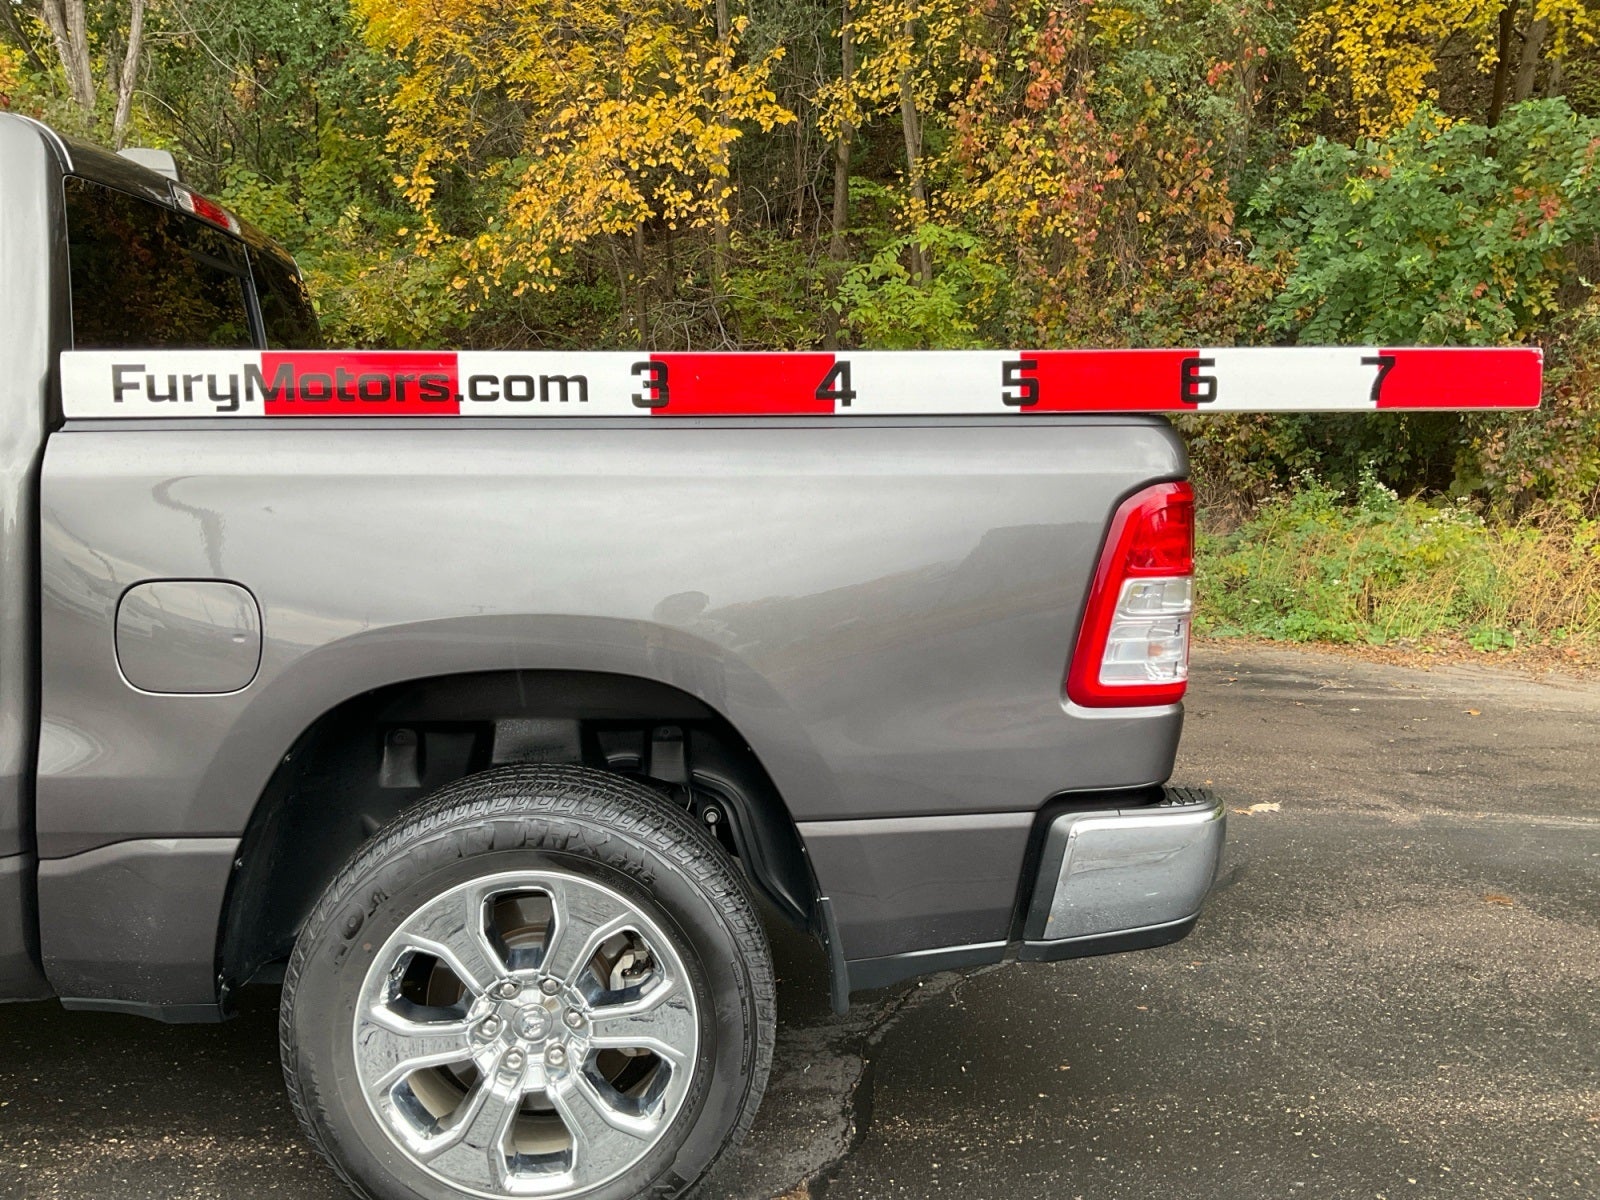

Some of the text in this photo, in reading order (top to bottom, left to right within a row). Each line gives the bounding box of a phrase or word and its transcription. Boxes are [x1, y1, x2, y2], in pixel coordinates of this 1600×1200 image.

[112, 356, 1396, 412] FuryMotors.com 3 4 5 6 7
